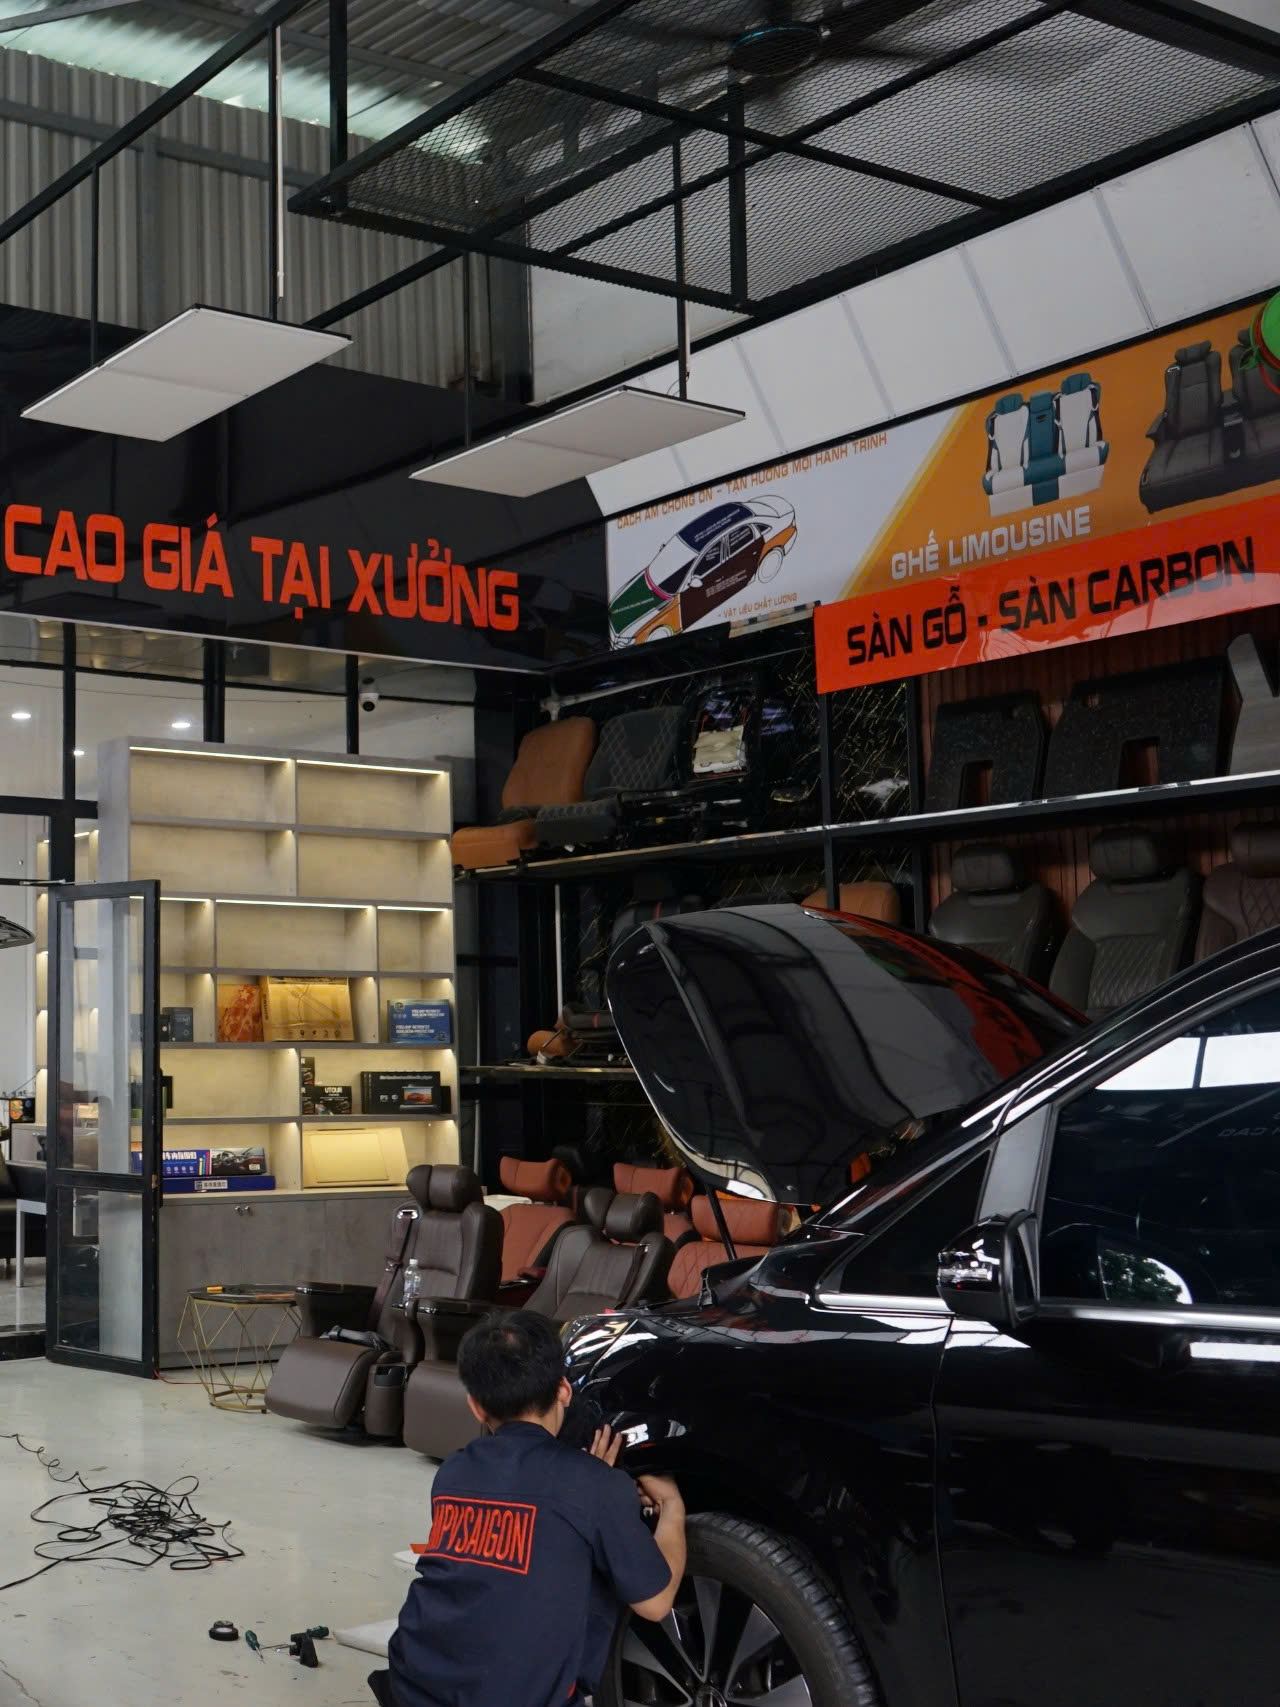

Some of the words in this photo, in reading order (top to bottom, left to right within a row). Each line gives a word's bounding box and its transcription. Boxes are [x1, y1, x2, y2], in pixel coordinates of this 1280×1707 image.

[5, 504, 126, 584] CAO
[143, 514, 235, 599] GIÁ
[251, 536, 332, 620] TẠI
[348, 539, 520, 632] XƯỞNG
[846, 611, 913, 666] SÀN
[922, 585, 968, 649] GỖ
[999, 575, 1078, 632] SÀN
[1087, 535, 1257, 616] CARBON
[891, 528, 940, 580] GHẾ
[948, 505, 1091, 567] LIMOUSINE
